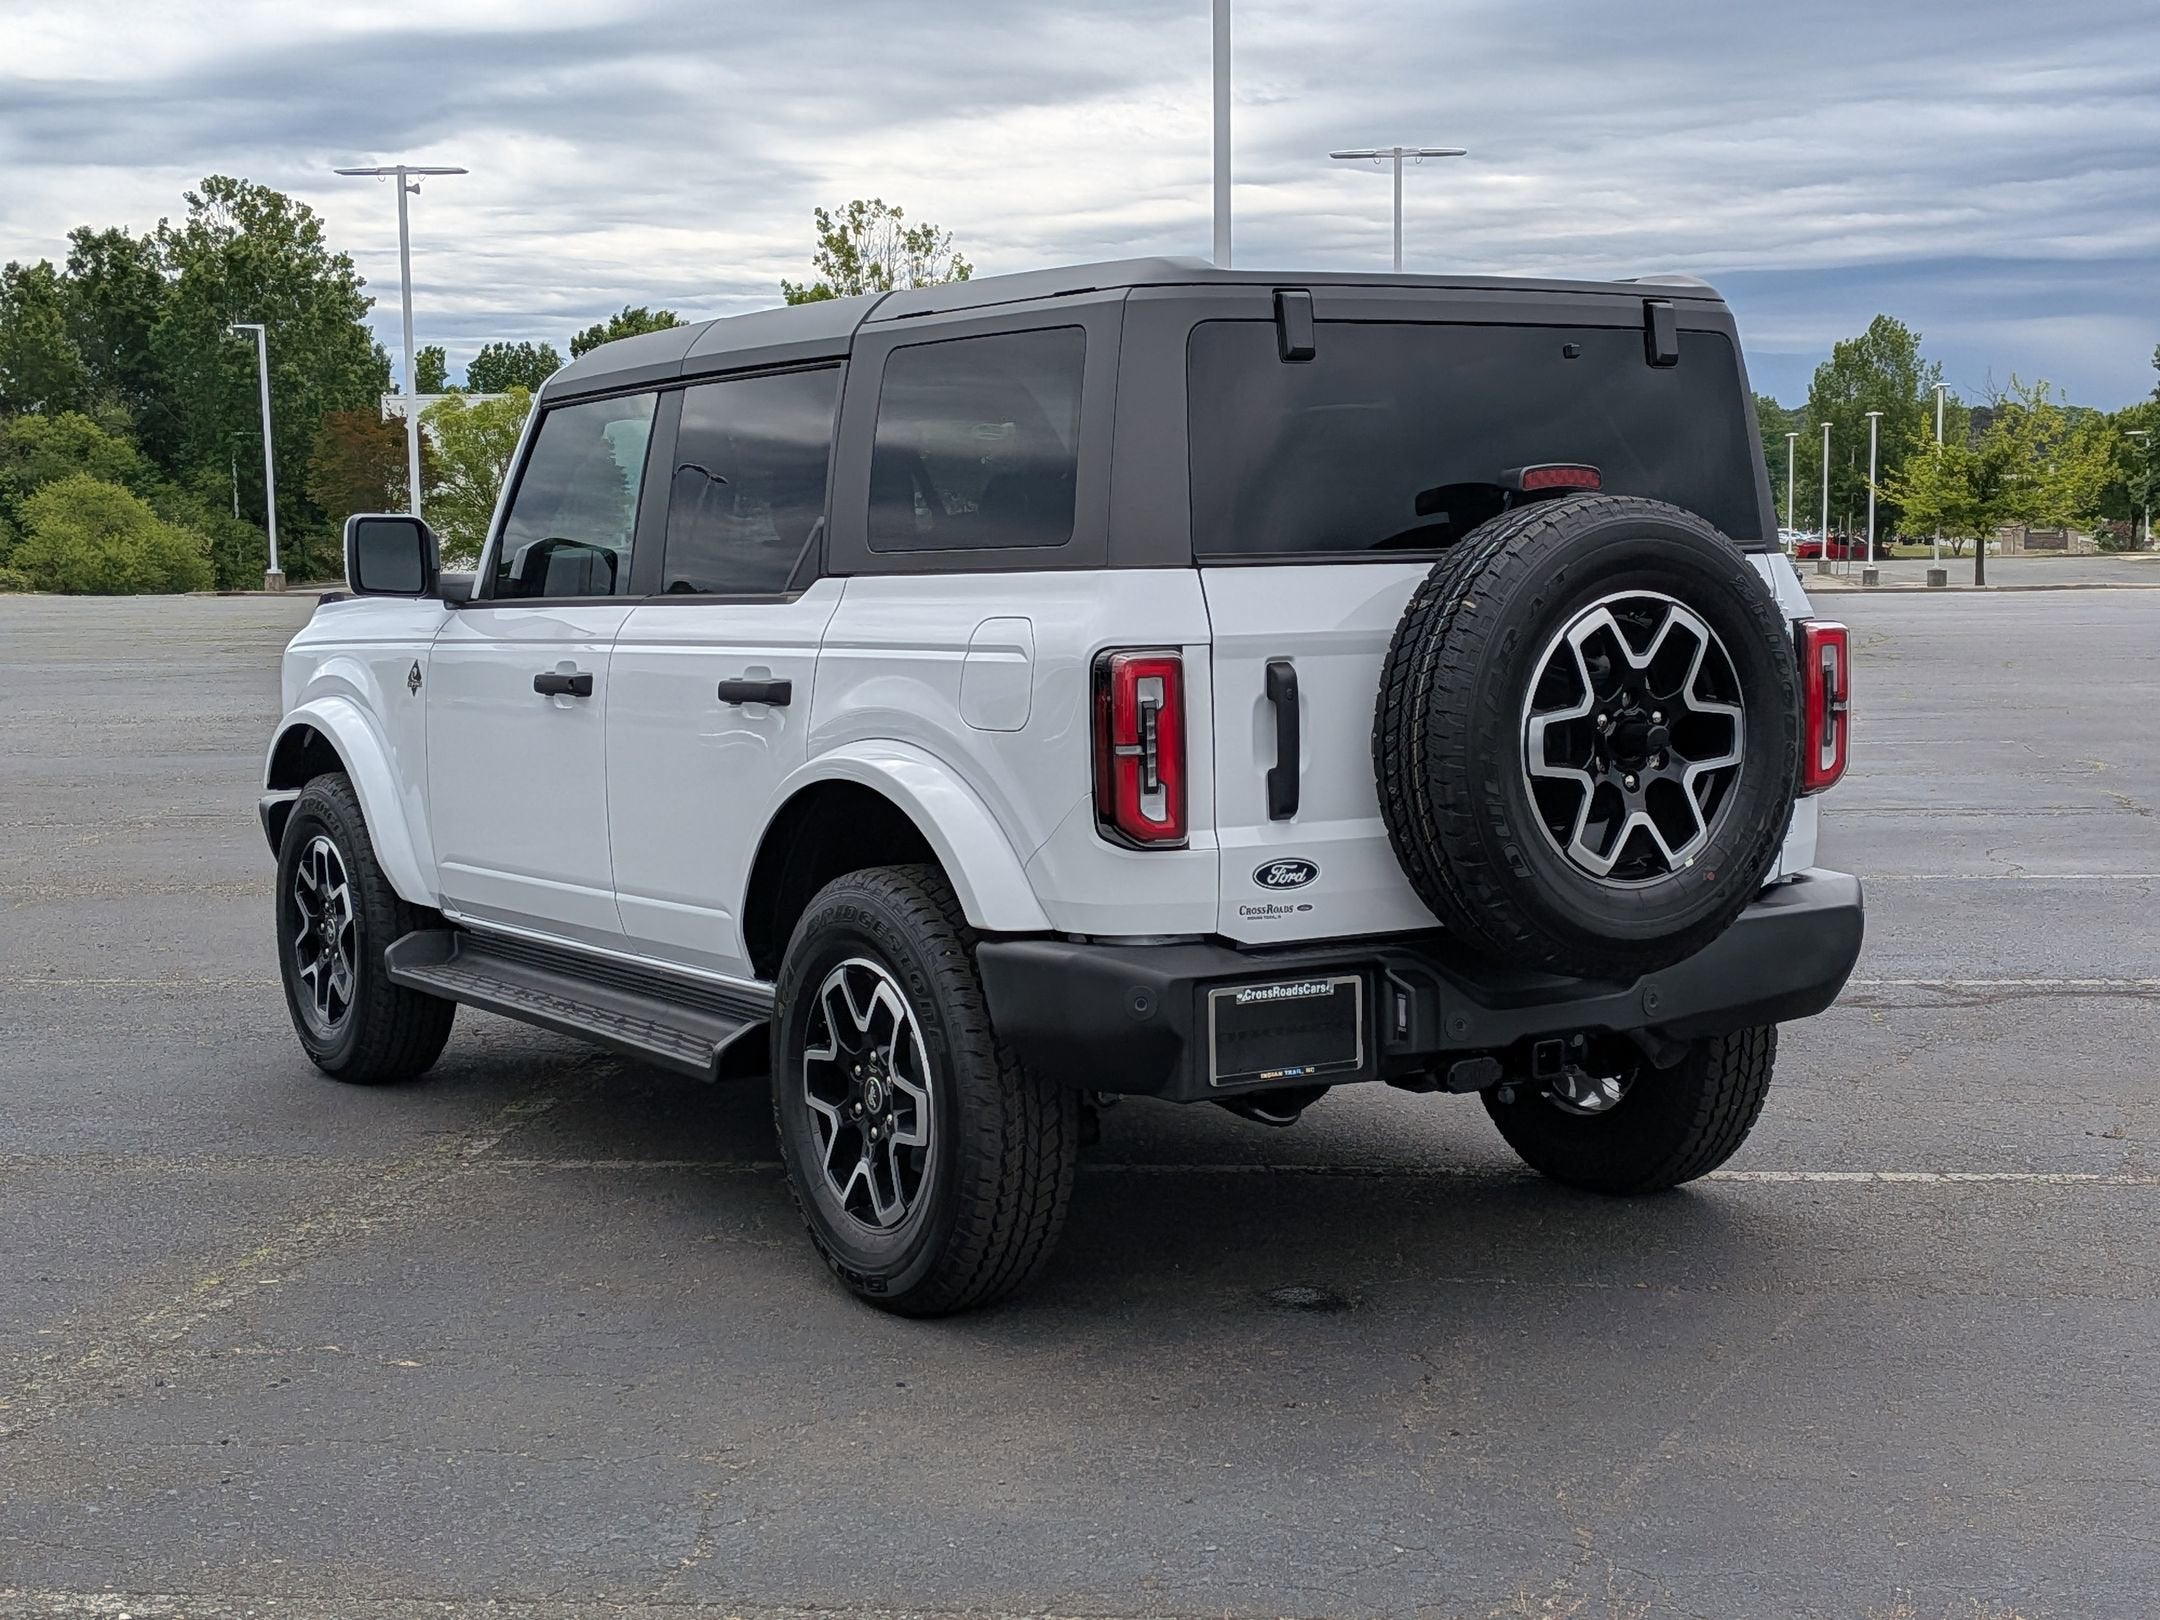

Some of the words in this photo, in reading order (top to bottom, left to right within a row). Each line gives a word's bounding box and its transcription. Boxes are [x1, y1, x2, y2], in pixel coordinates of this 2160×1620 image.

[1267, 863, 1308, 884] Ford
[805, 904, 943, 1051] BRIDGESTONE
[1245, 983, 1325, 1002] CrossRoadsCars
